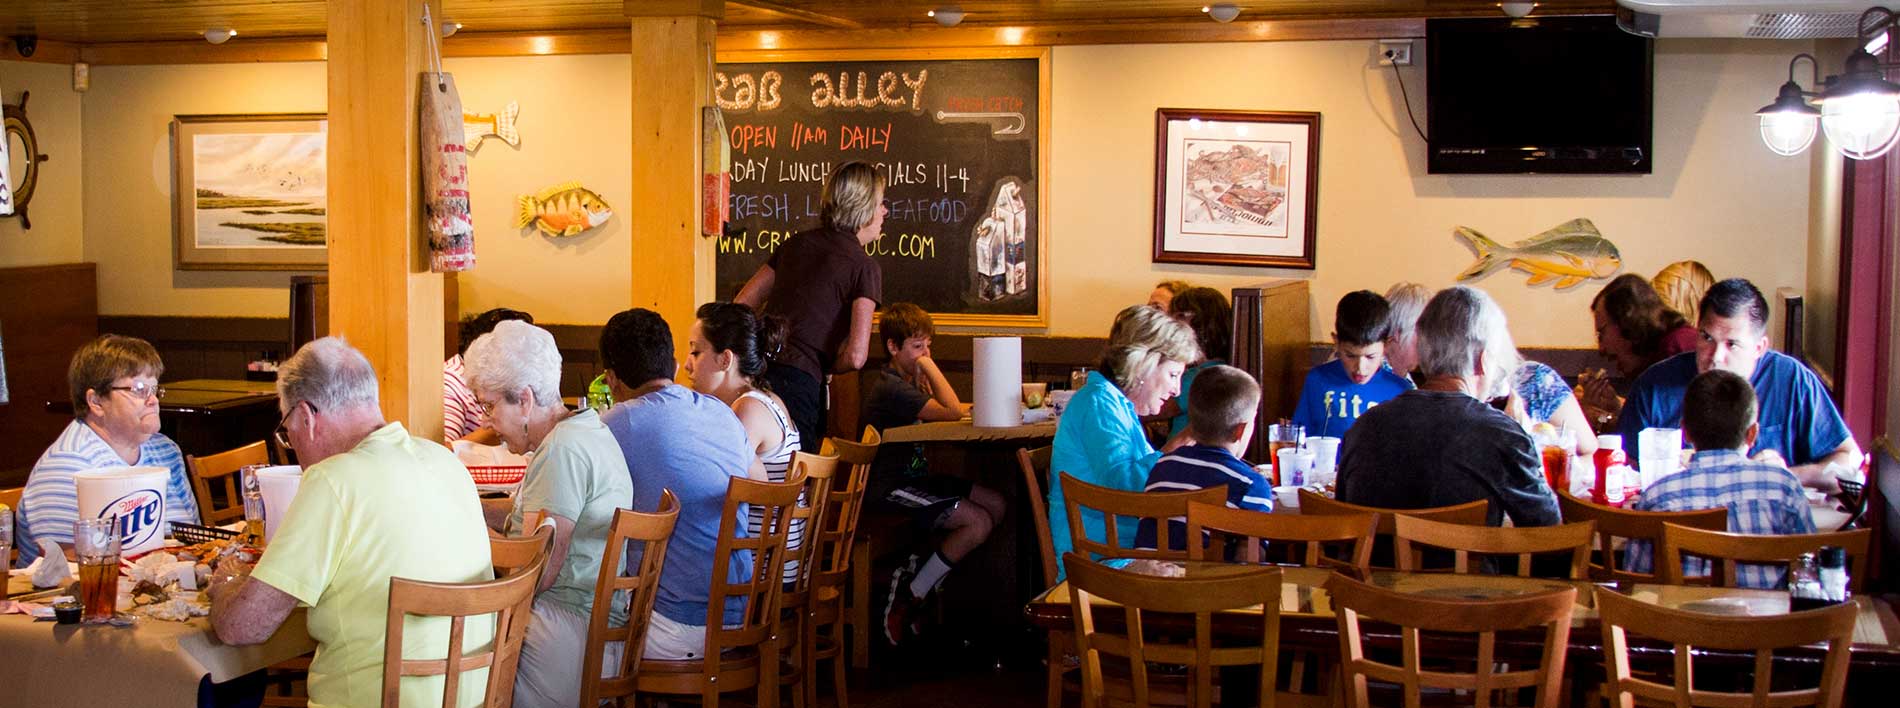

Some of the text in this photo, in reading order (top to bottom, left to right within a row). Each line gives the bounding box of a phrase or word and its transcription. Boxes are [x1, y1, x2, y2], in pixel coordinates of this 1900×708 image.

[730, 122, 892, 154] OPEN 11AM DAILY
[778, 159, 832, 186] LUNCH
[936, 163, 970, 193] 11-4
